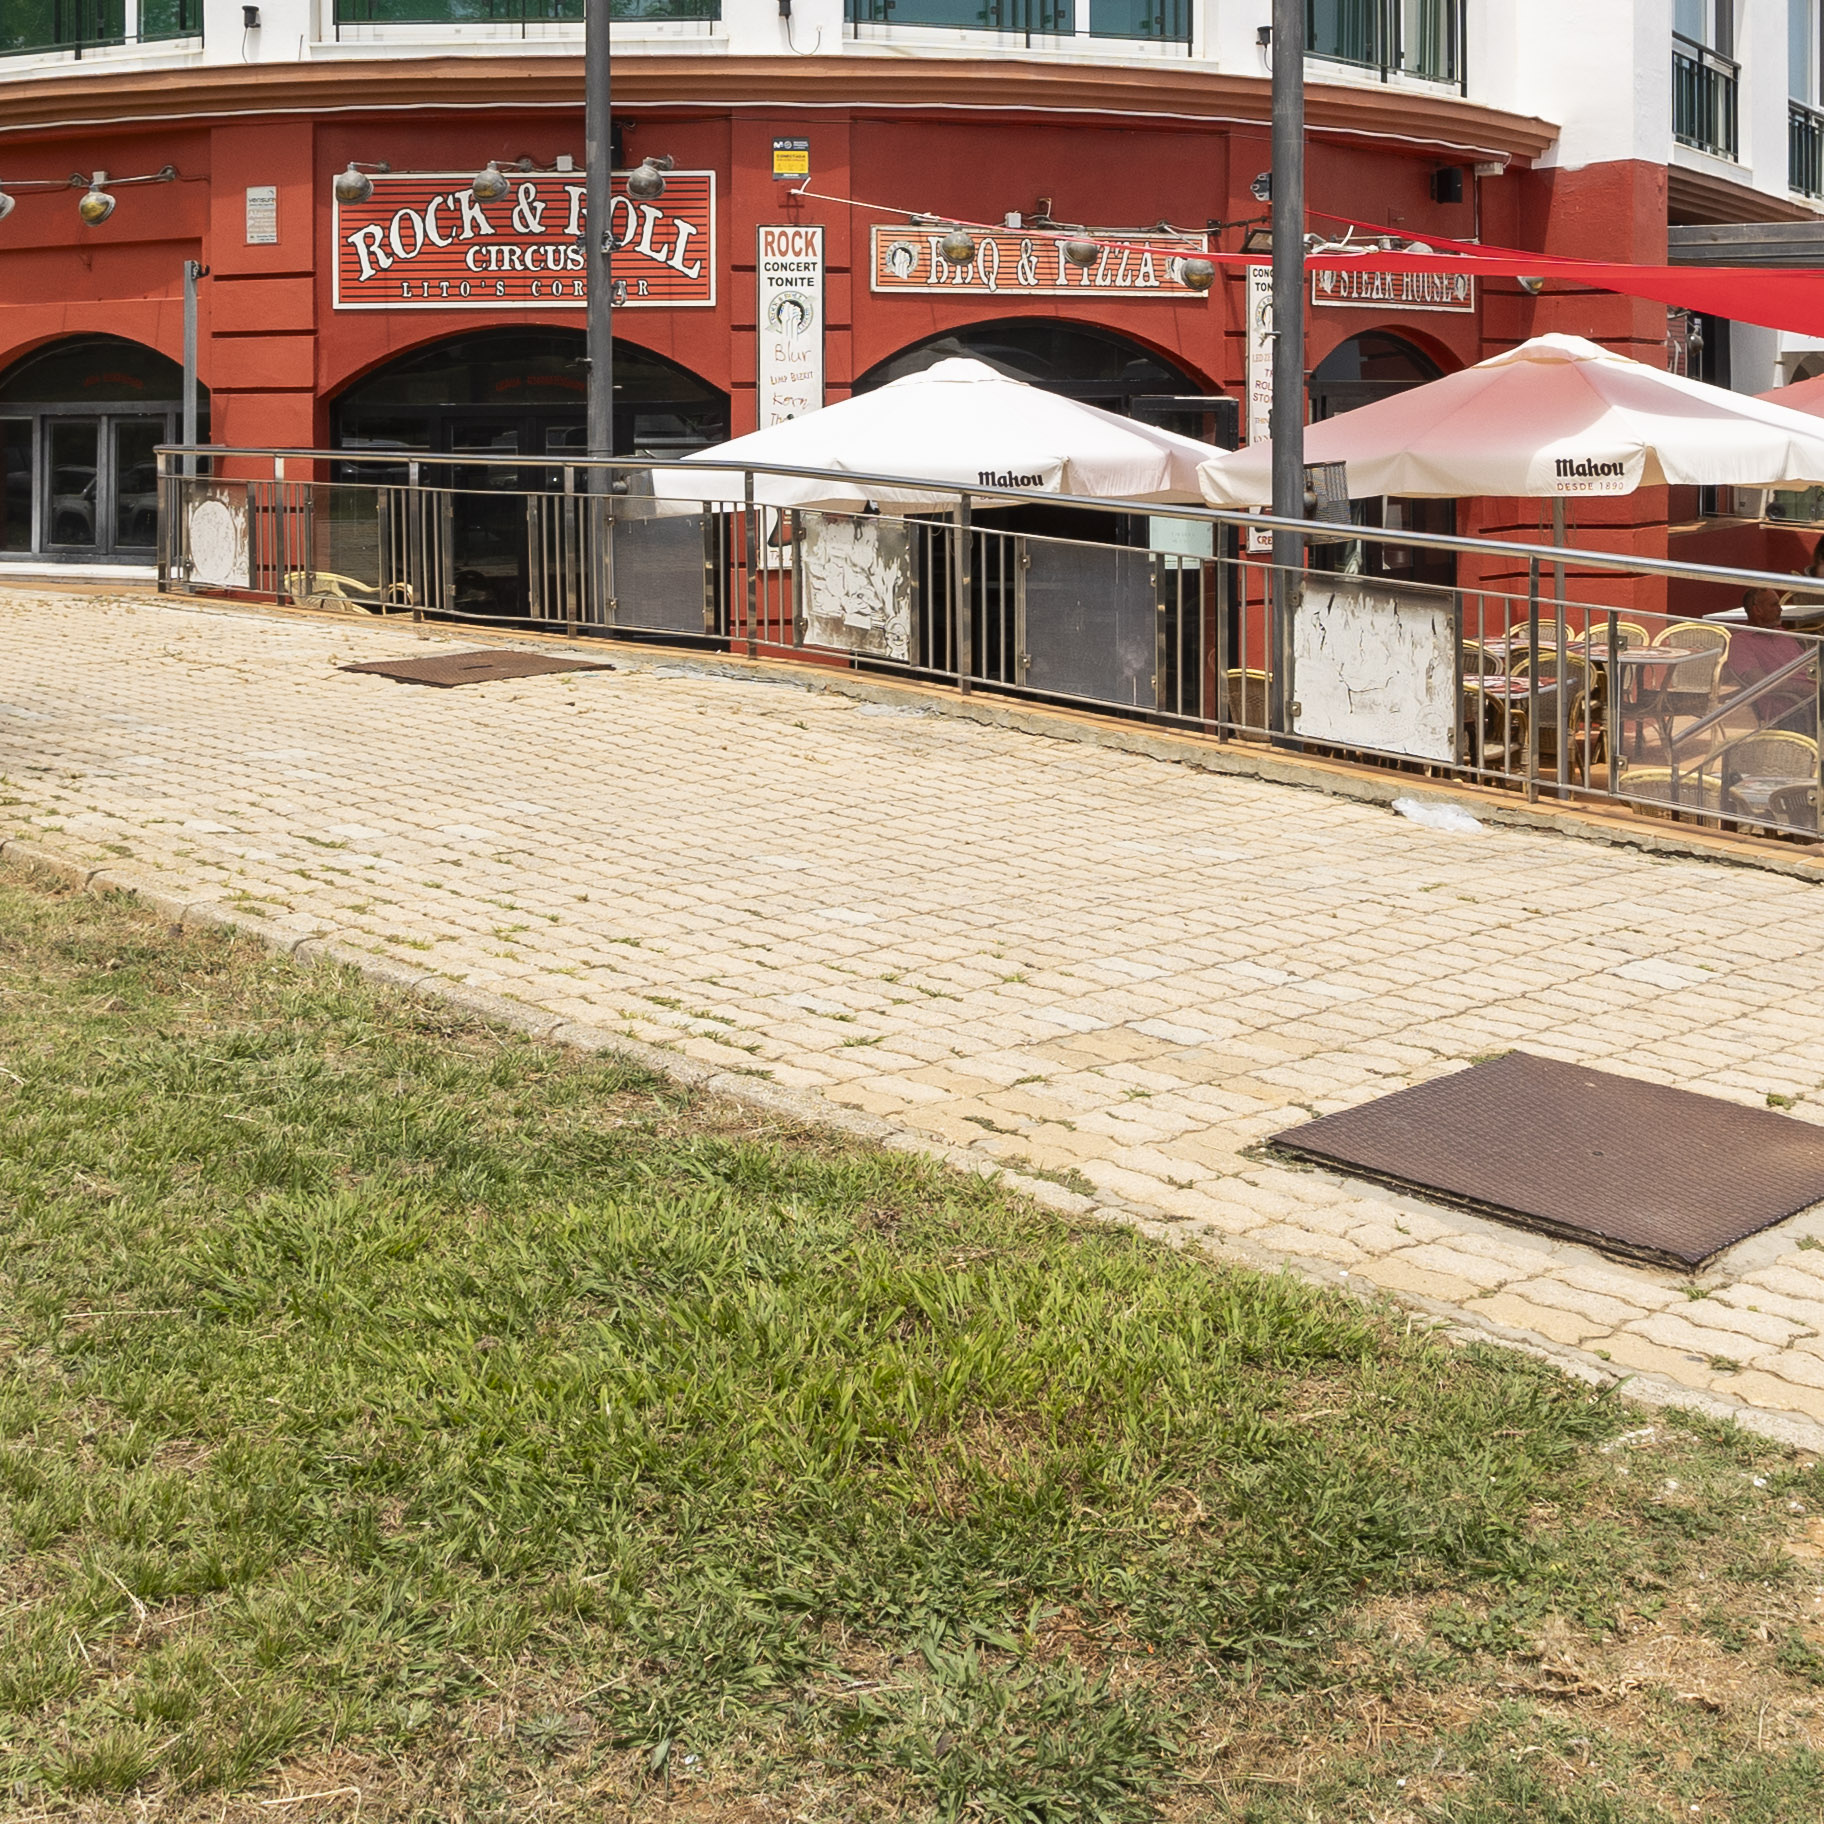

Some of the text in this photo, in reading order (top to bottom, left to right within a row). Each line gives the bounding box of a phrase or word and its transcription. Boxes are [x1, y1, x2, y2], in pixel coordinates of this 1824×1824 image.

[347, 188, 496, 282] ROCK
[512, 182, 546, 235] &
[764, 230, 817, 257] ROCK
[465, 245, 586, 272] CIRCUS
[764, 262, 817, 272] CONCERT
[1017, 238, 1039, 286] &
[401, 281, 505, 298] LITO'S
[767, 277, 814, 287] TONITE
[774, 340, 812, 363] Blur
[1555, 457, 1625, 477] Mahou
[978, 470, 1045, 488] Mahou
[1557, 481, 1624, 491] DESDE 1890
